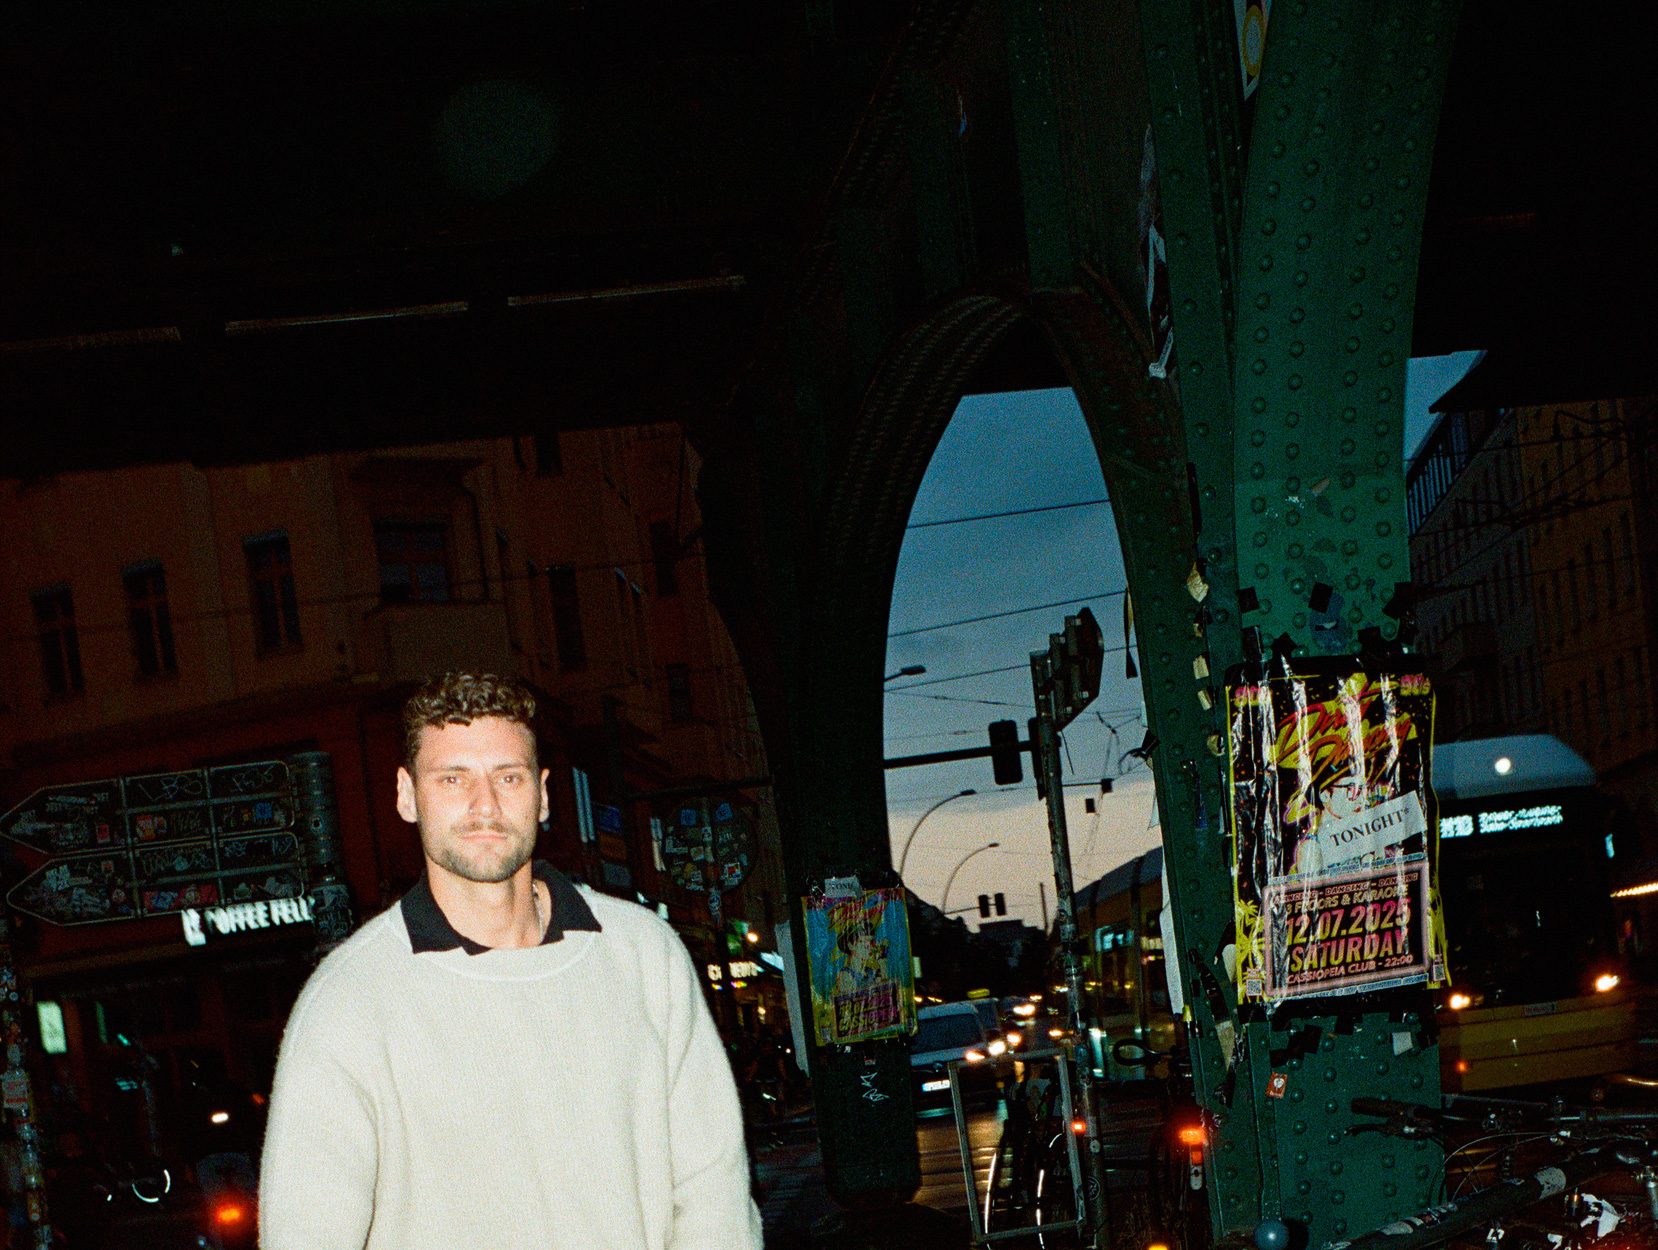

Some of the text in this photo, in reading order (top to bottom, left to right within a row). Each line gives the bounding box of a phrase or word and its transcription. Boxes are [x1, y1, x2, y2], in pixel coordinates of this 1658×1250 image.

[1276, 684, 1382, 764] Diry
[1378, 872, 1419, 888] DANING
[1286, 897, 1412, 946] 12.07.2025
[1286, 965, 1346, 985] CASSIOPEIA
[1347, 960, 1377, 974] CLUB
[1384, 954, 1414, 968] 22:00
[1290, 928, 1409, 973] SATURDAY
